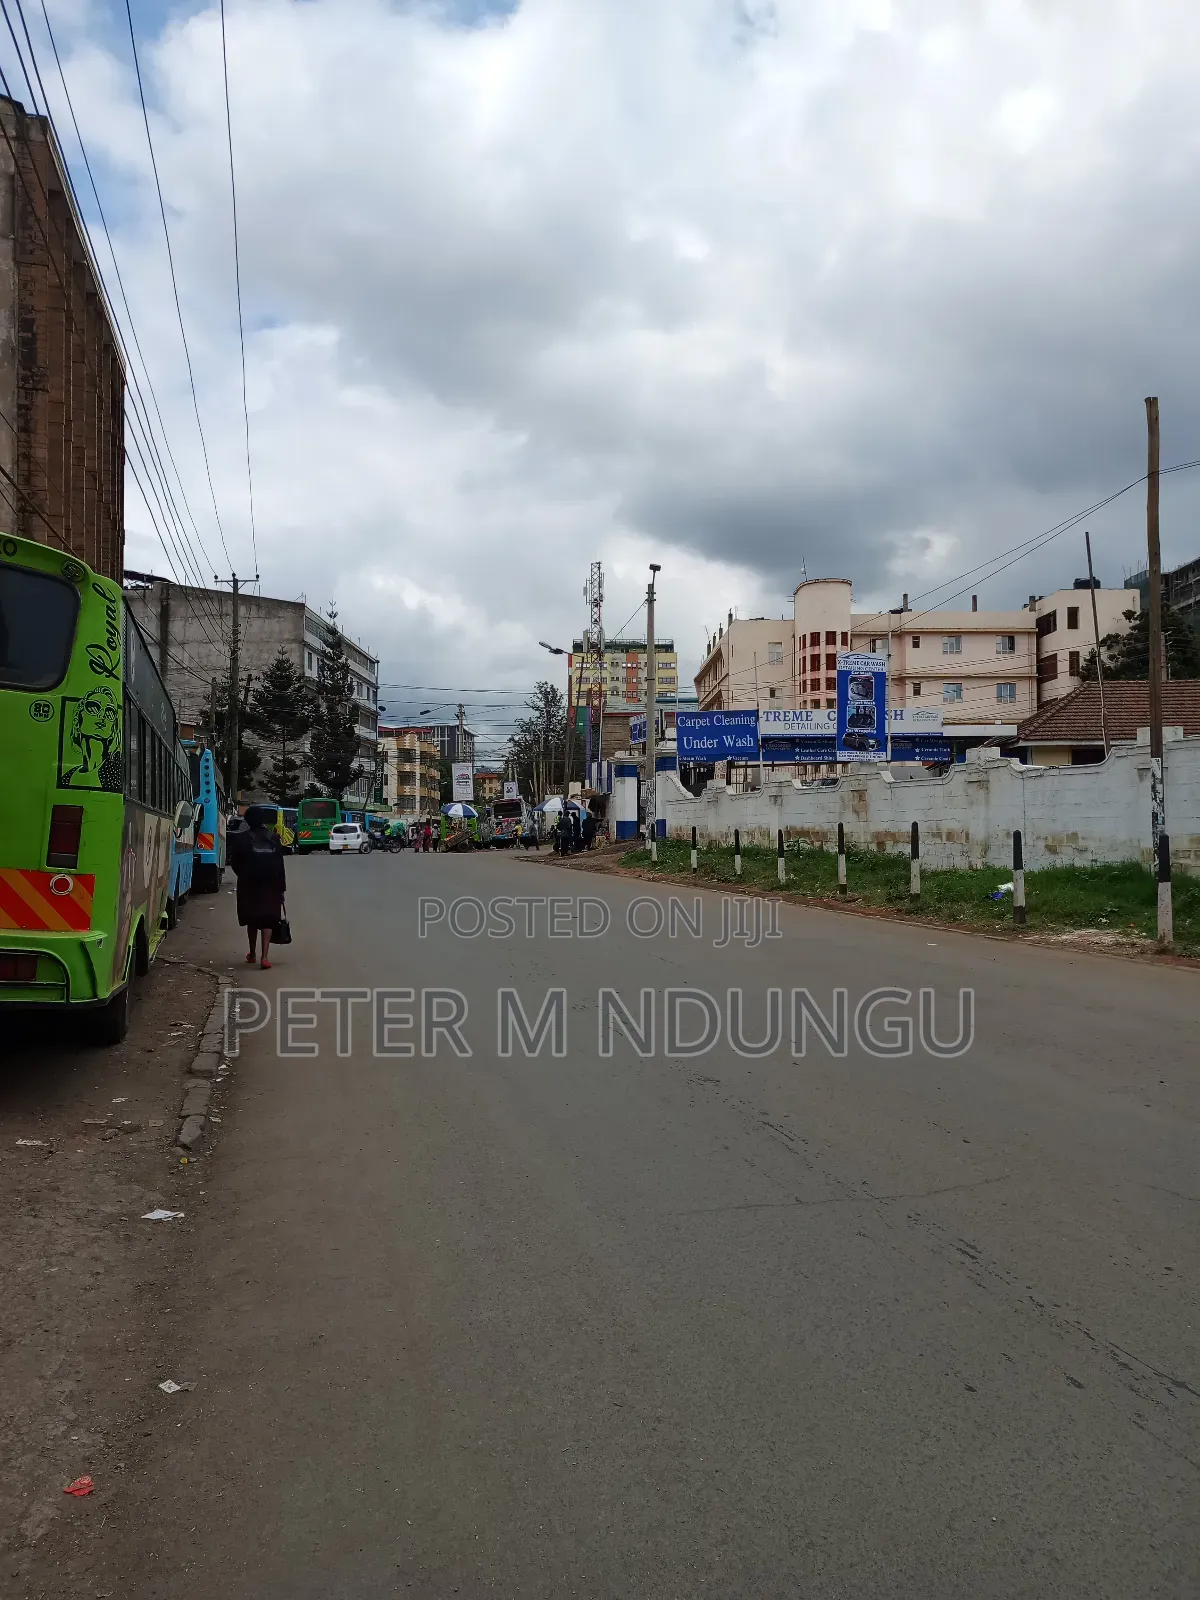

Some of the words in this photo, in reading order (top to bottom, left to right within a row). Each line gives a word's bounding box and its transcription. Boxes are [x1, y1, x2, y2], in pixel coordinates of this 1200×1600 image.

[86, 582, 121, 681] Royal
[677, 716, 711, 730] Carpet
[713, 714, 756, 728] Cleaning
[760, 711, 814, 722] -TREME
[784, 722, 830, 731] DETAILING
[682, 735, 719, 750] Under
[722, 734, 754, 748] Wash
